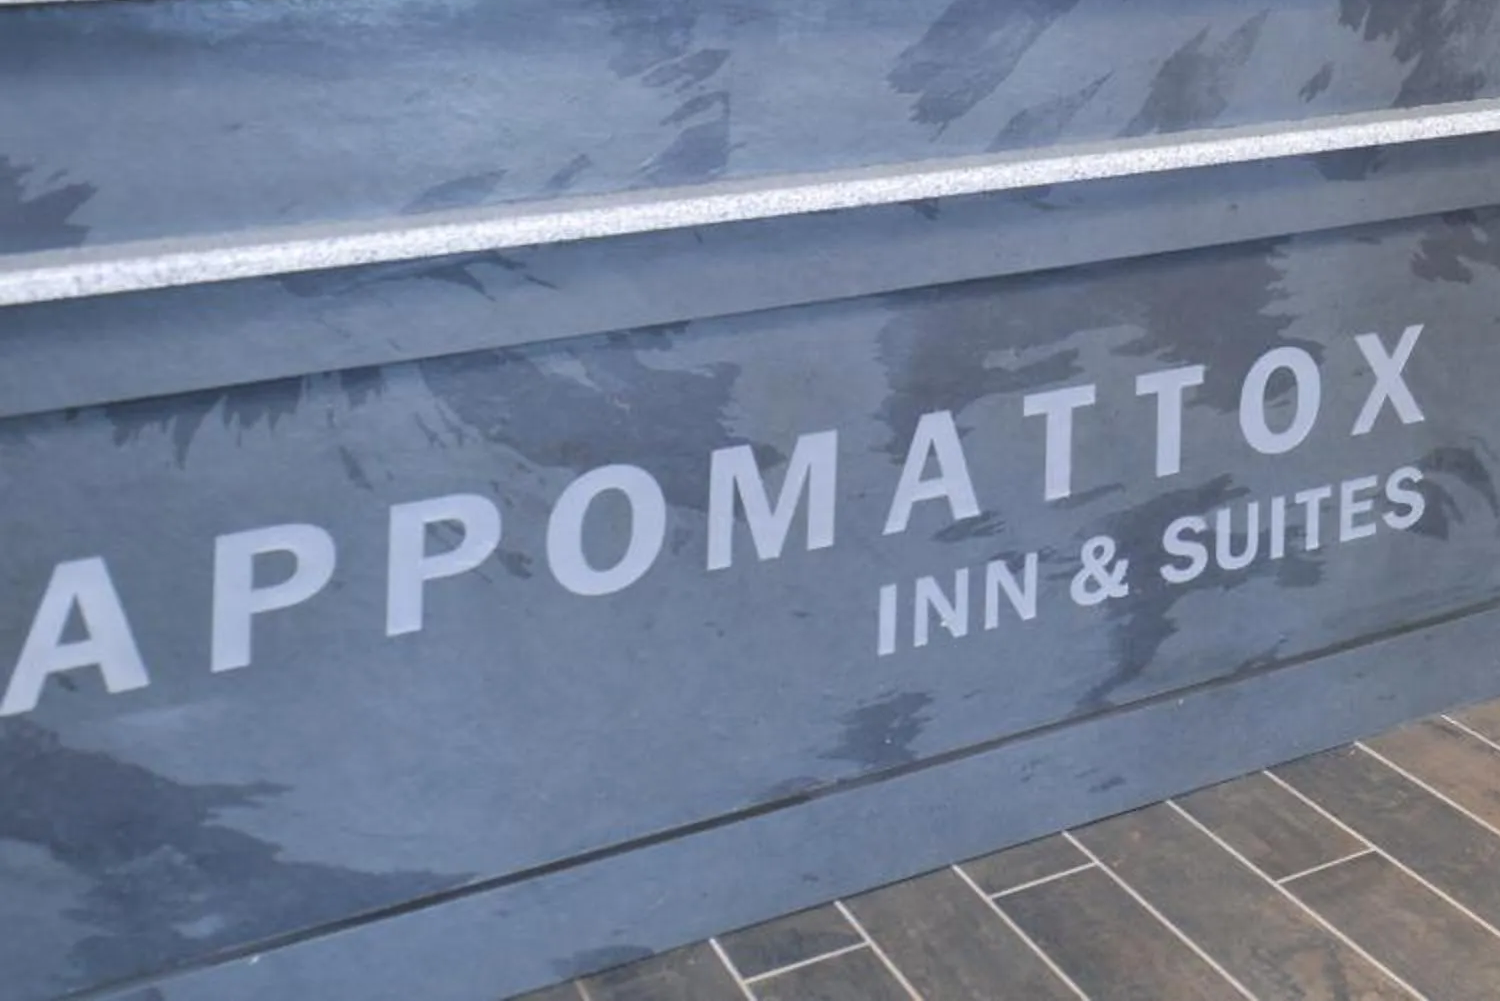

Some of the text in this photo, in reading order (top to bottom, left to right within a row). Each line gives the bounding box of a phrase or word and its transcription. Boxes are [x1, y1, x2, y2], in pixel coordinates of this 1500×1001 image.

[0, 324, 1426, 717] APPOMATTOX
[877, 465, 1426, 657] INN & SUITES
